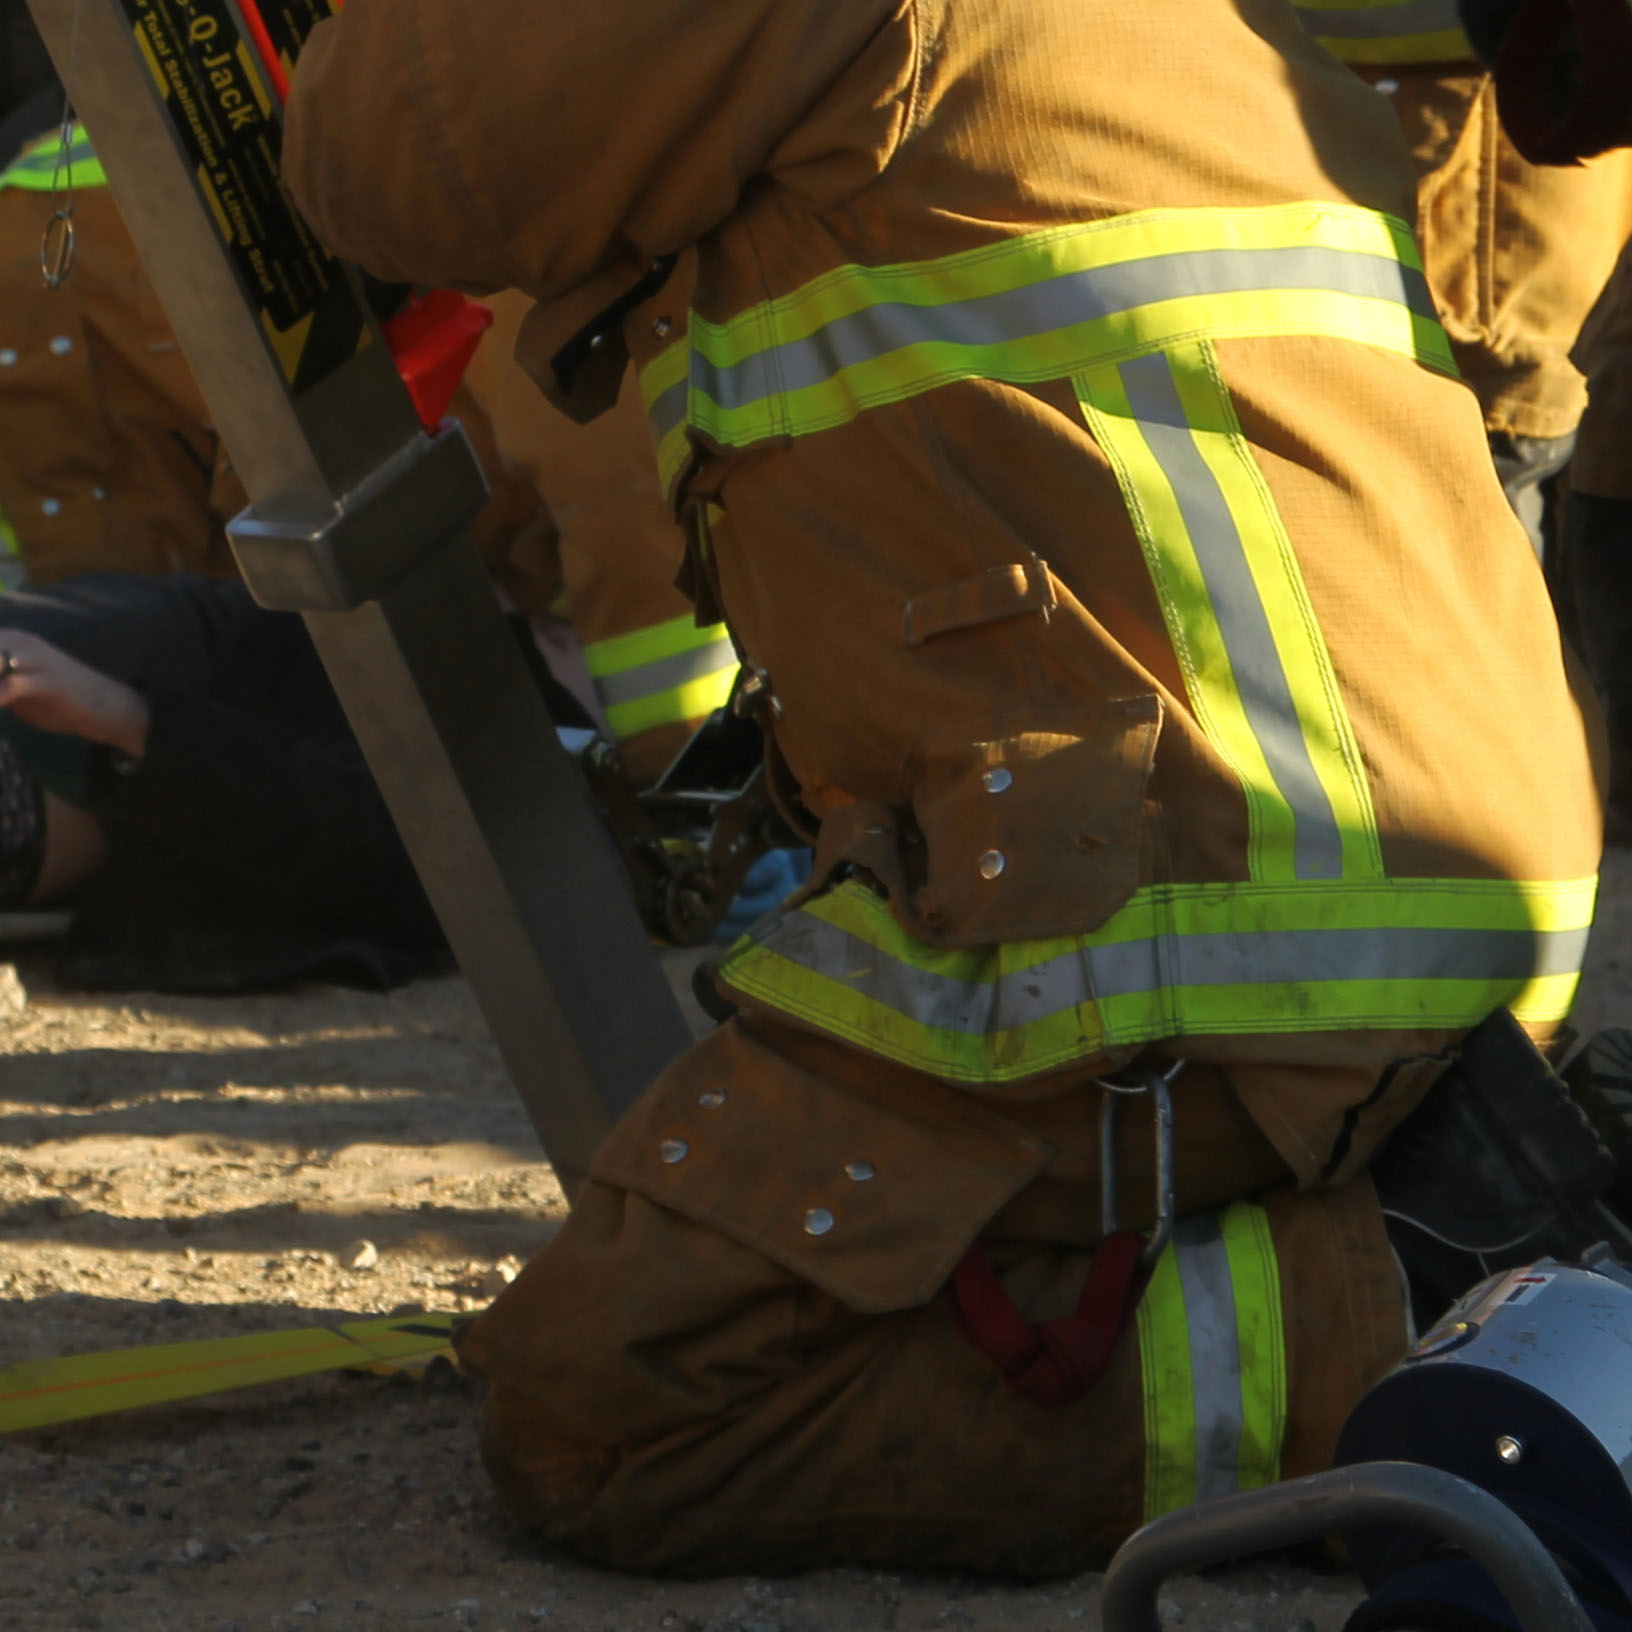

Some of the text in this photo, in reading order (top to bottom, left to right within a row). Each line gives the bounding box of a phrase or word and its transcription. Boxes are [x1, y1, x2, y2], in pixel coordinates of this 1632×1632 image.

[143, 9, 172, 57] Total
[163, 57, 220, 168] Stabilization
[213, 169, 228, 186] &
[221, 187, 254, 247] Lifting
[247, 246, 276, 293] Strut
